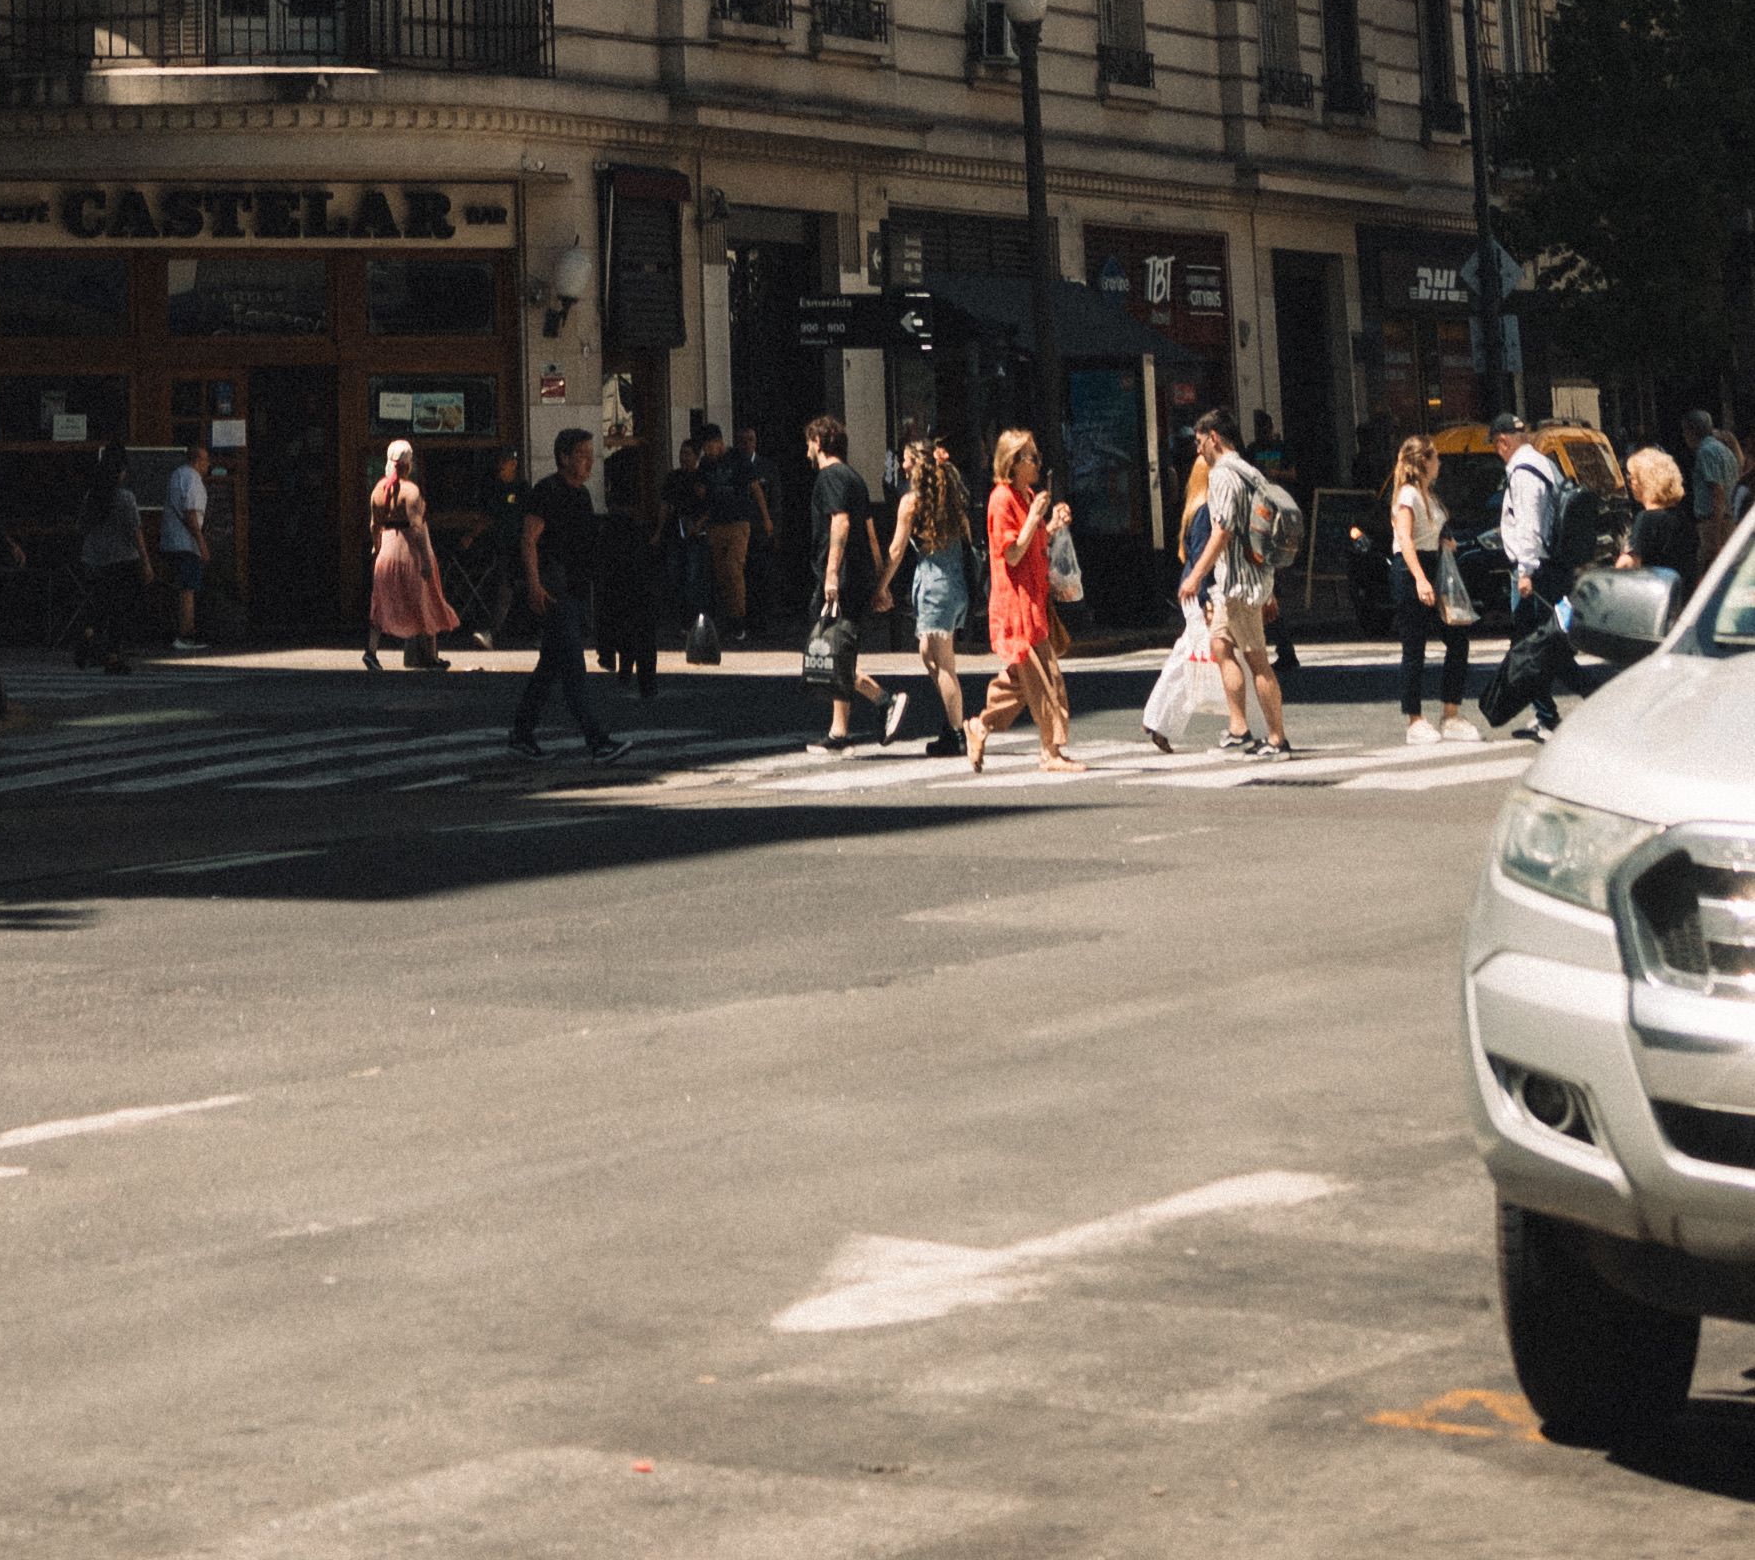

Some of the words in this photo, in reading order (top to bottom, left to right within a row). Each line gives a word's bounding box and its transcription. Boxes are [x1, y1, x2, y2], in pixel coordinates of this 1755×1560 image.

[61, 190, 456, 239] CASTELAR
[464, 206, 507, 225] BAR
[1143, 254, 1176, 305] TBT
[1413, 266, 1465, 303] DHL
[798, 296, 852, 308] Esmeralda
[1189, 289, 1222, 308] CITYBUS
